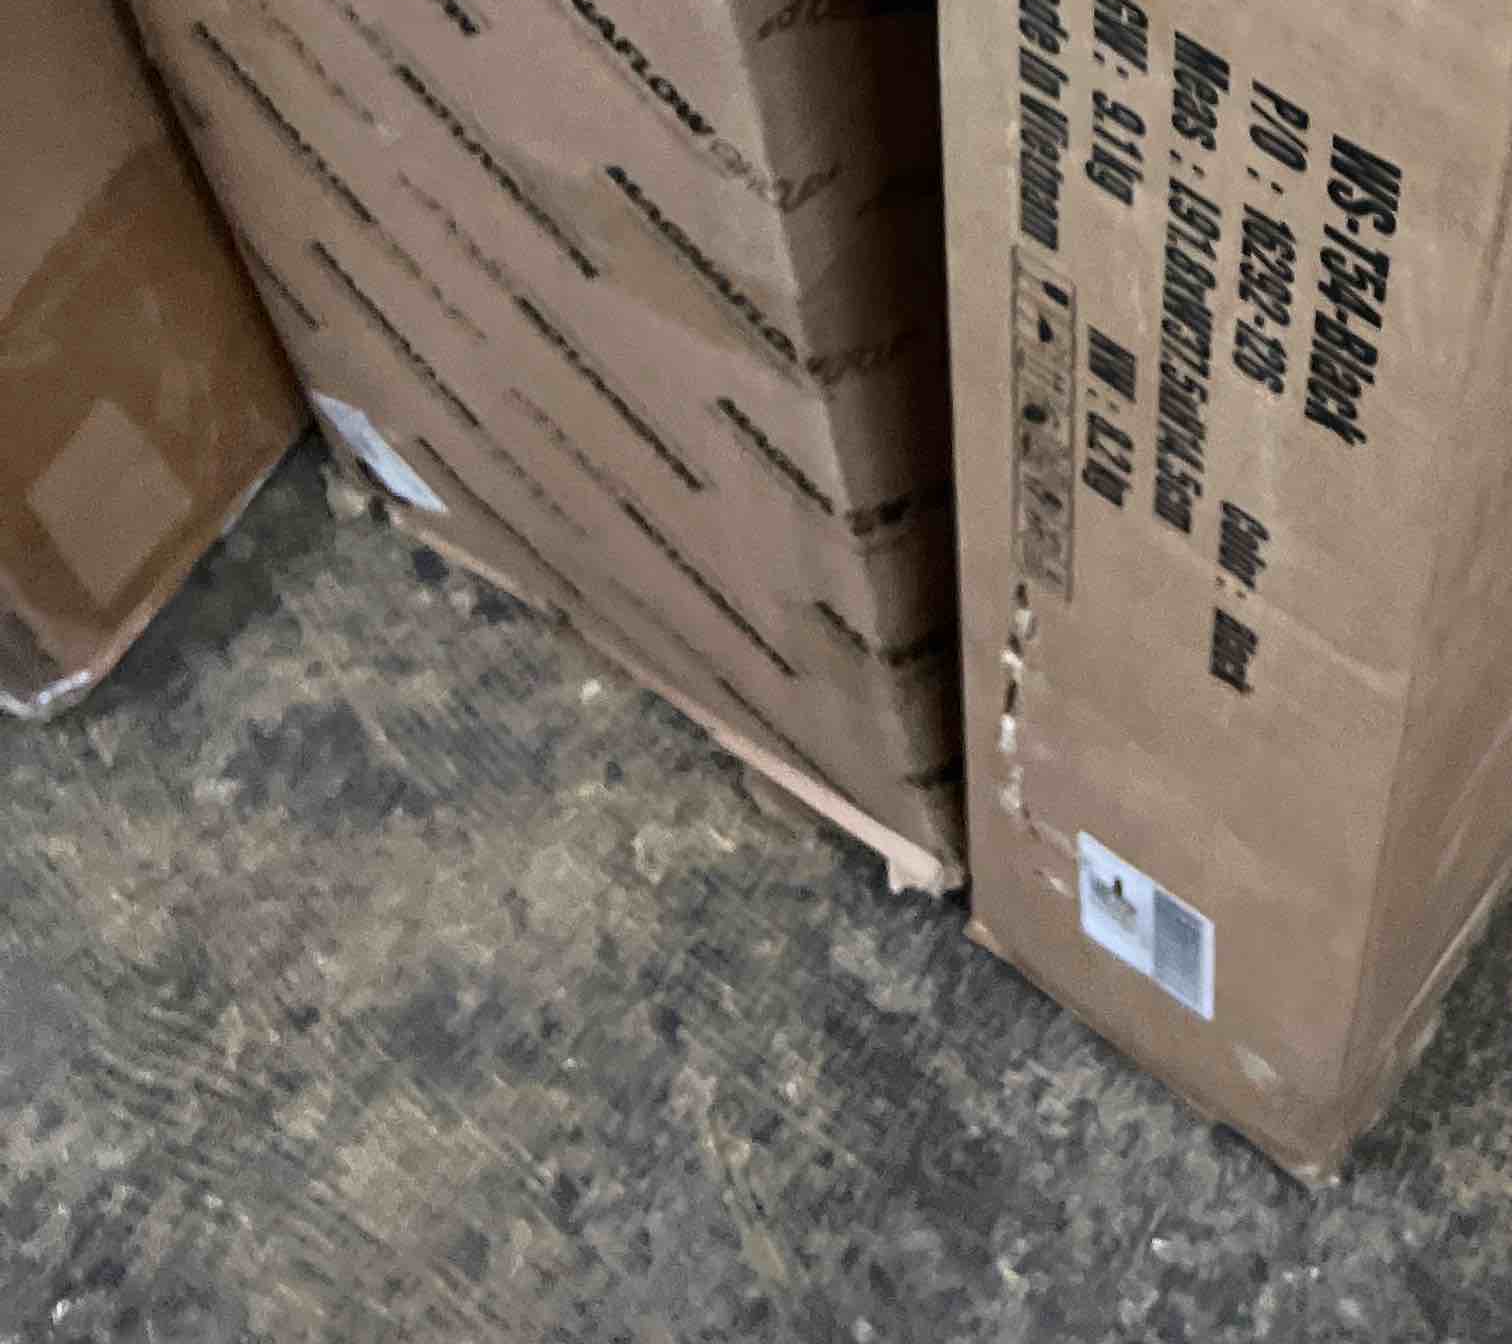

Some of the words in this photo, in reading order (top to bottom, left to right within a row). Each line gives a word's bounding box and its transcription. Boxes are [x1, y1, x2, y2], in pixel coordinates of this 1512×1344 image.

[1170, 29, 1232, 152] Meas
[1249, 78, 1310, 173] P/O
[1019, 91, 1071, 253] Vietnam
[1233, 202, 1298, 396] 16292-126
[1304, 133, 1402, 447] WS-T54-Black
